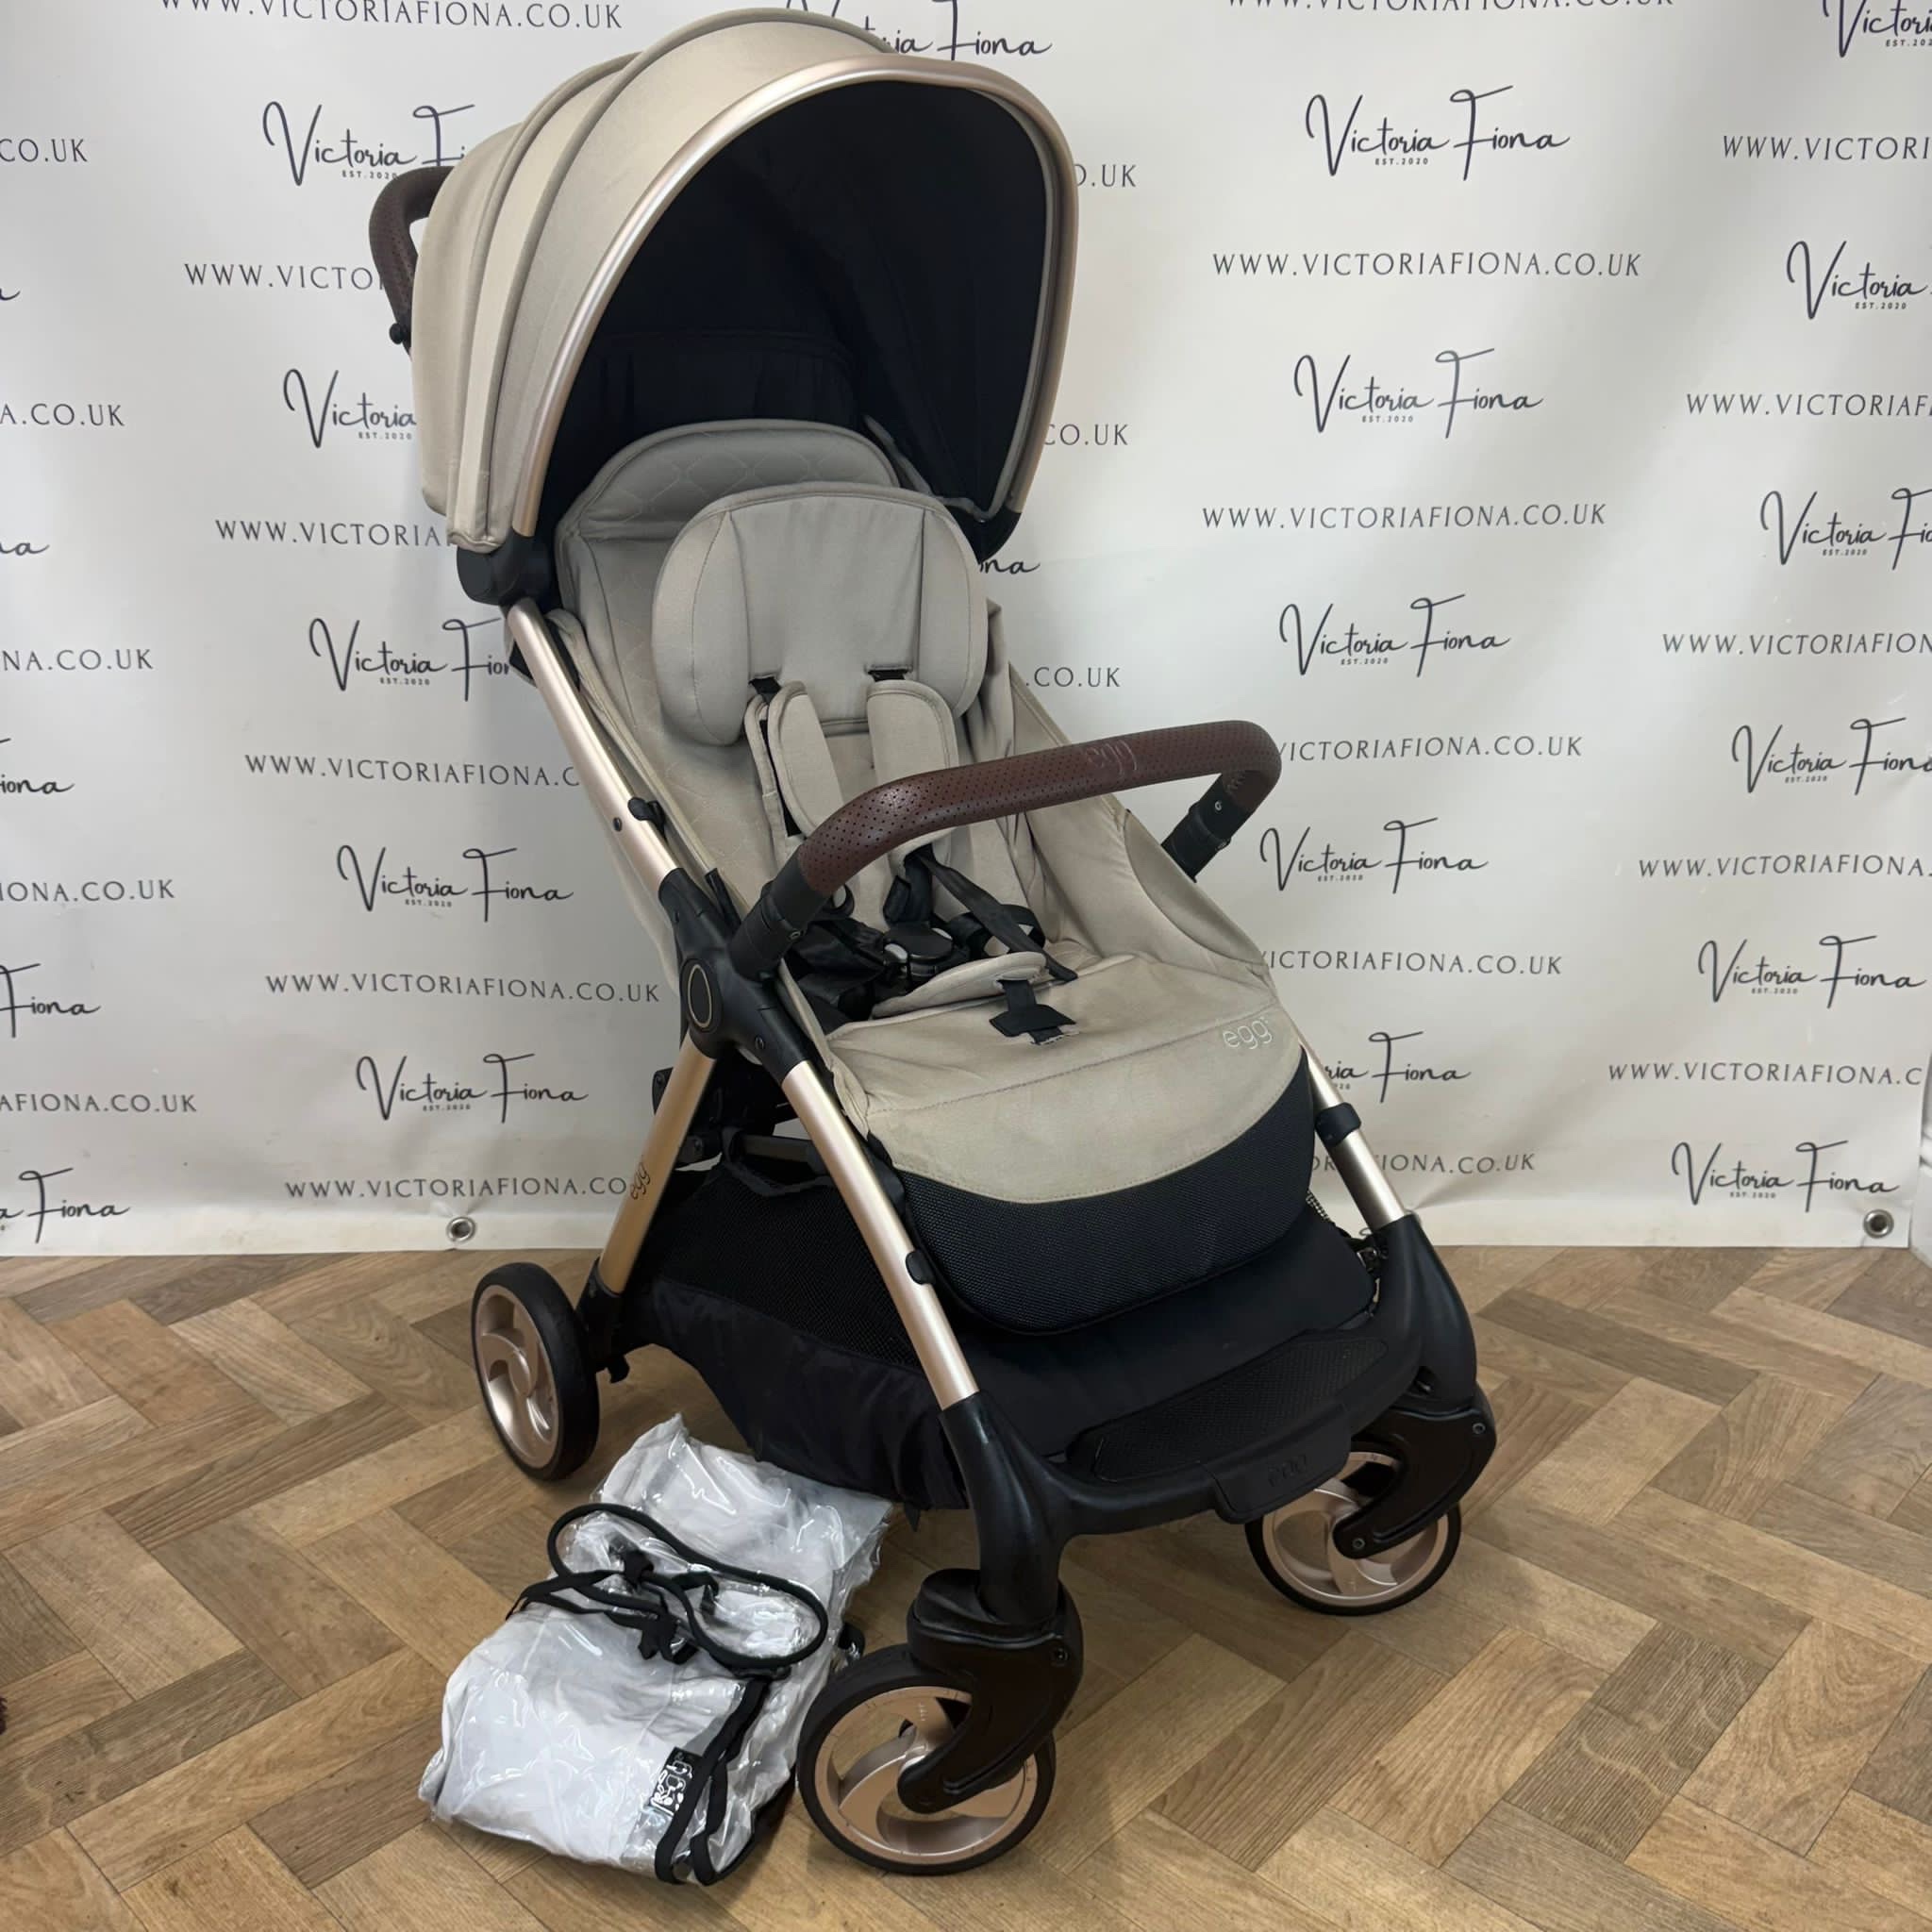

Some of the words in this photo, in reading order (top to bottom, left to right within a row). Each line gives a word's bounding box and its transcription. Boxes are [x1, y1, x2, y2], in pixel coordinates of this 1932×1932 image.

[1823, 0, 1932, 58] Victori
[262, 101, 417, 187] Victoria
[1306, 94, 1451, 176] Victoria
[1450, 85, 1570, 181] Fiona
[1724, 136, 1930, 160] WWW.VICTORI
[184, 263, 383, 290] WWW.VICTO
[1212, 252, 1641, 276] WWW.VICTORIAFIONA.CO.UK
[1786, 241, 1928, 320] Victoria
[283, 368, 416, 449] Victoria
[1293, 355, 1436, 434] Victoria
[1435, 348, 1543, 439] Fiona
[215, 520, 449, 546] WWW.VICTORIA
[1203, 504, 1606, 528] WWW.VICTORIAFIONA.CO.UK
[1760, 491, 1887, 565] Victoria
[308, 618, 447, 691] Victoria
[1279, 604, 1408, 675] Victoria
[1409, 593, 1511, 678] Fiona
[1731, 724, 1846, 793] Victoria
[337, 845, 469, 912] Victoria
[462, 848, 574, 923] Fiona
[1259, 826, 1382, 891] Victoria
[1383, 817, 1489, 894] Fiona
[265, 974, 658, 1002] WWW.VICTORIAFIONA.CO.UK
[1698, 939, 1818, 1003] Victoria
[1818, 935, 1927, 1009] Fiona
[1223, 1018, 1273, 1050] egg
[1368, 1031, 1471, 1104] Fiona
[356, 1055, 488, 1121] Victoria
[483, 1054, 589, 1124] Fiona
[19, 1168, 130, 1244] Fiona
[1672, 1141, 1794, 1206] Victoria
[1795, 1141, 1900, 1212] Fiona
